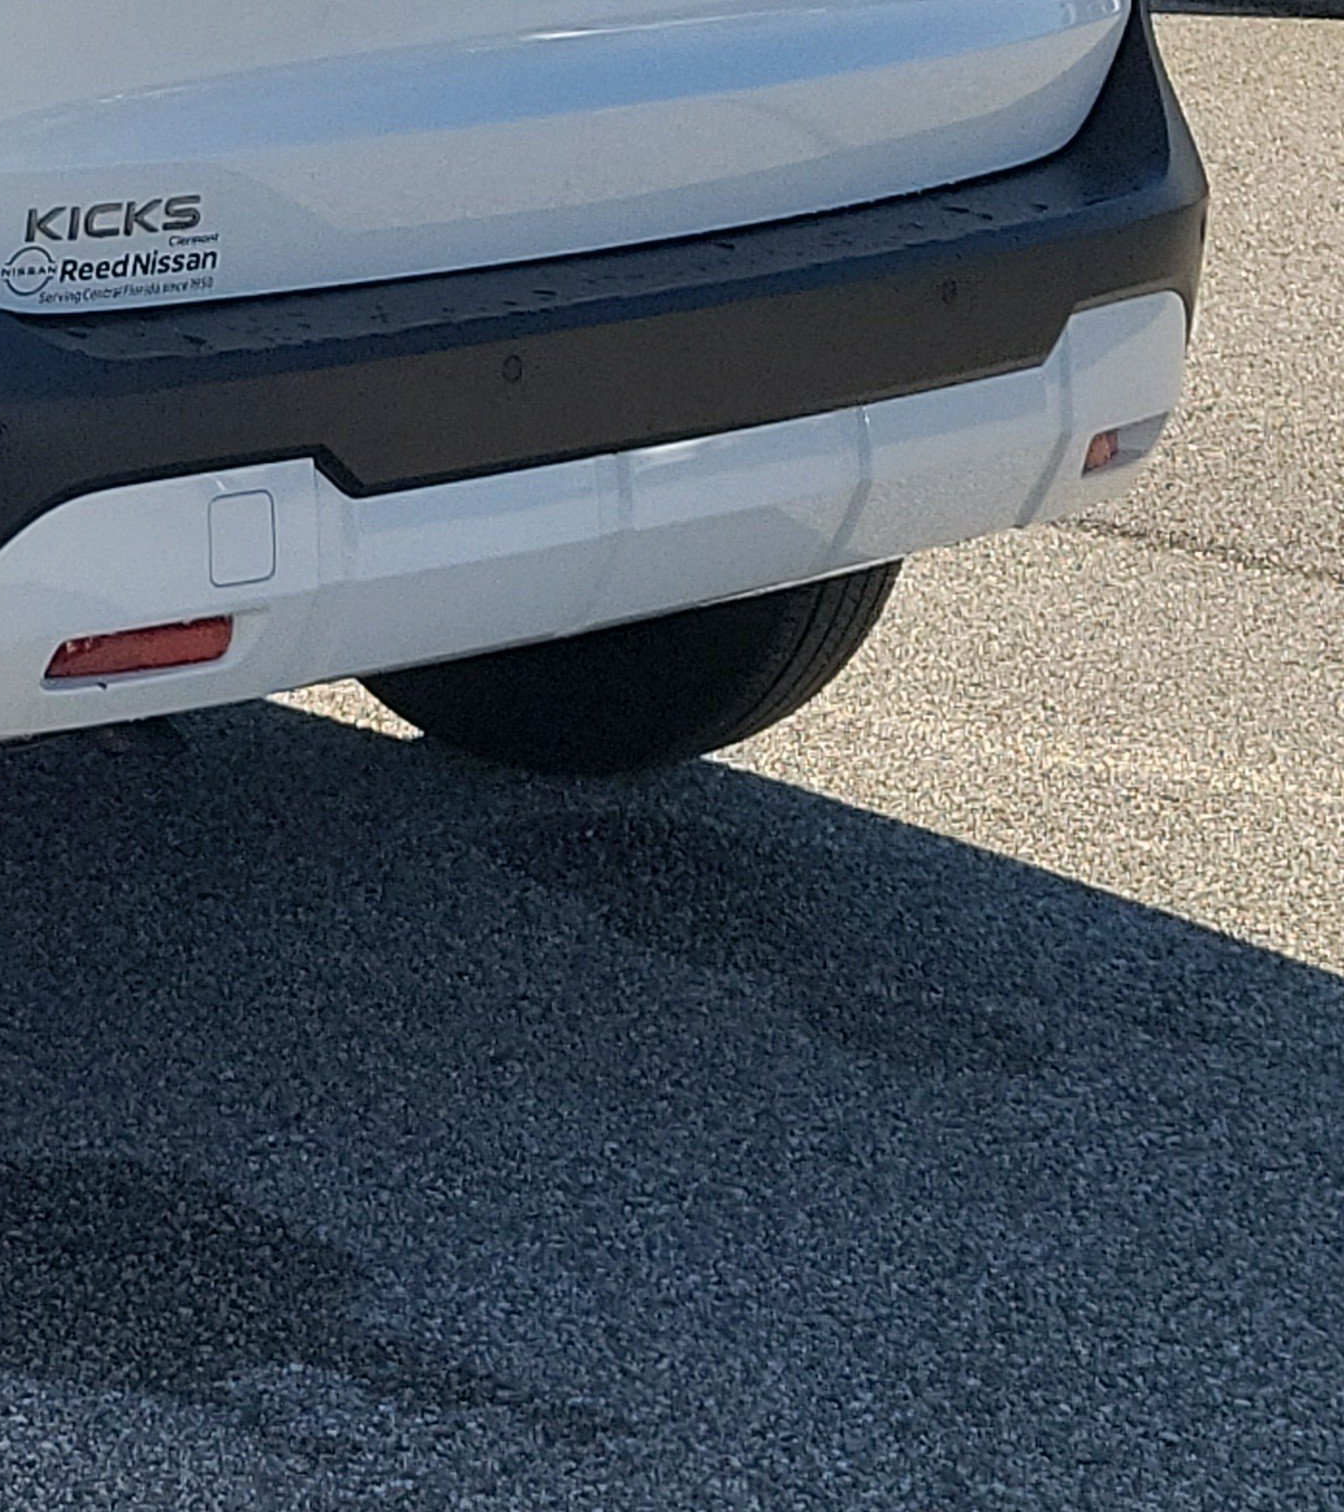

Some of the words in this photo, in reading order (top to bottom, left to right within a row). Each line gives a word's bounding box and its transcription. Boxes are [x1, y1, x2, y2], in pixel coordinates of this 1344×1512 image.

[25, 195, 201, 242] KICKS
[1, 264, 57, 277] NISSAN
[60, 253, 130, 283] Reed
[131, 249, 217, 277] Nissan
[38, 290, 82, 305] Serving
